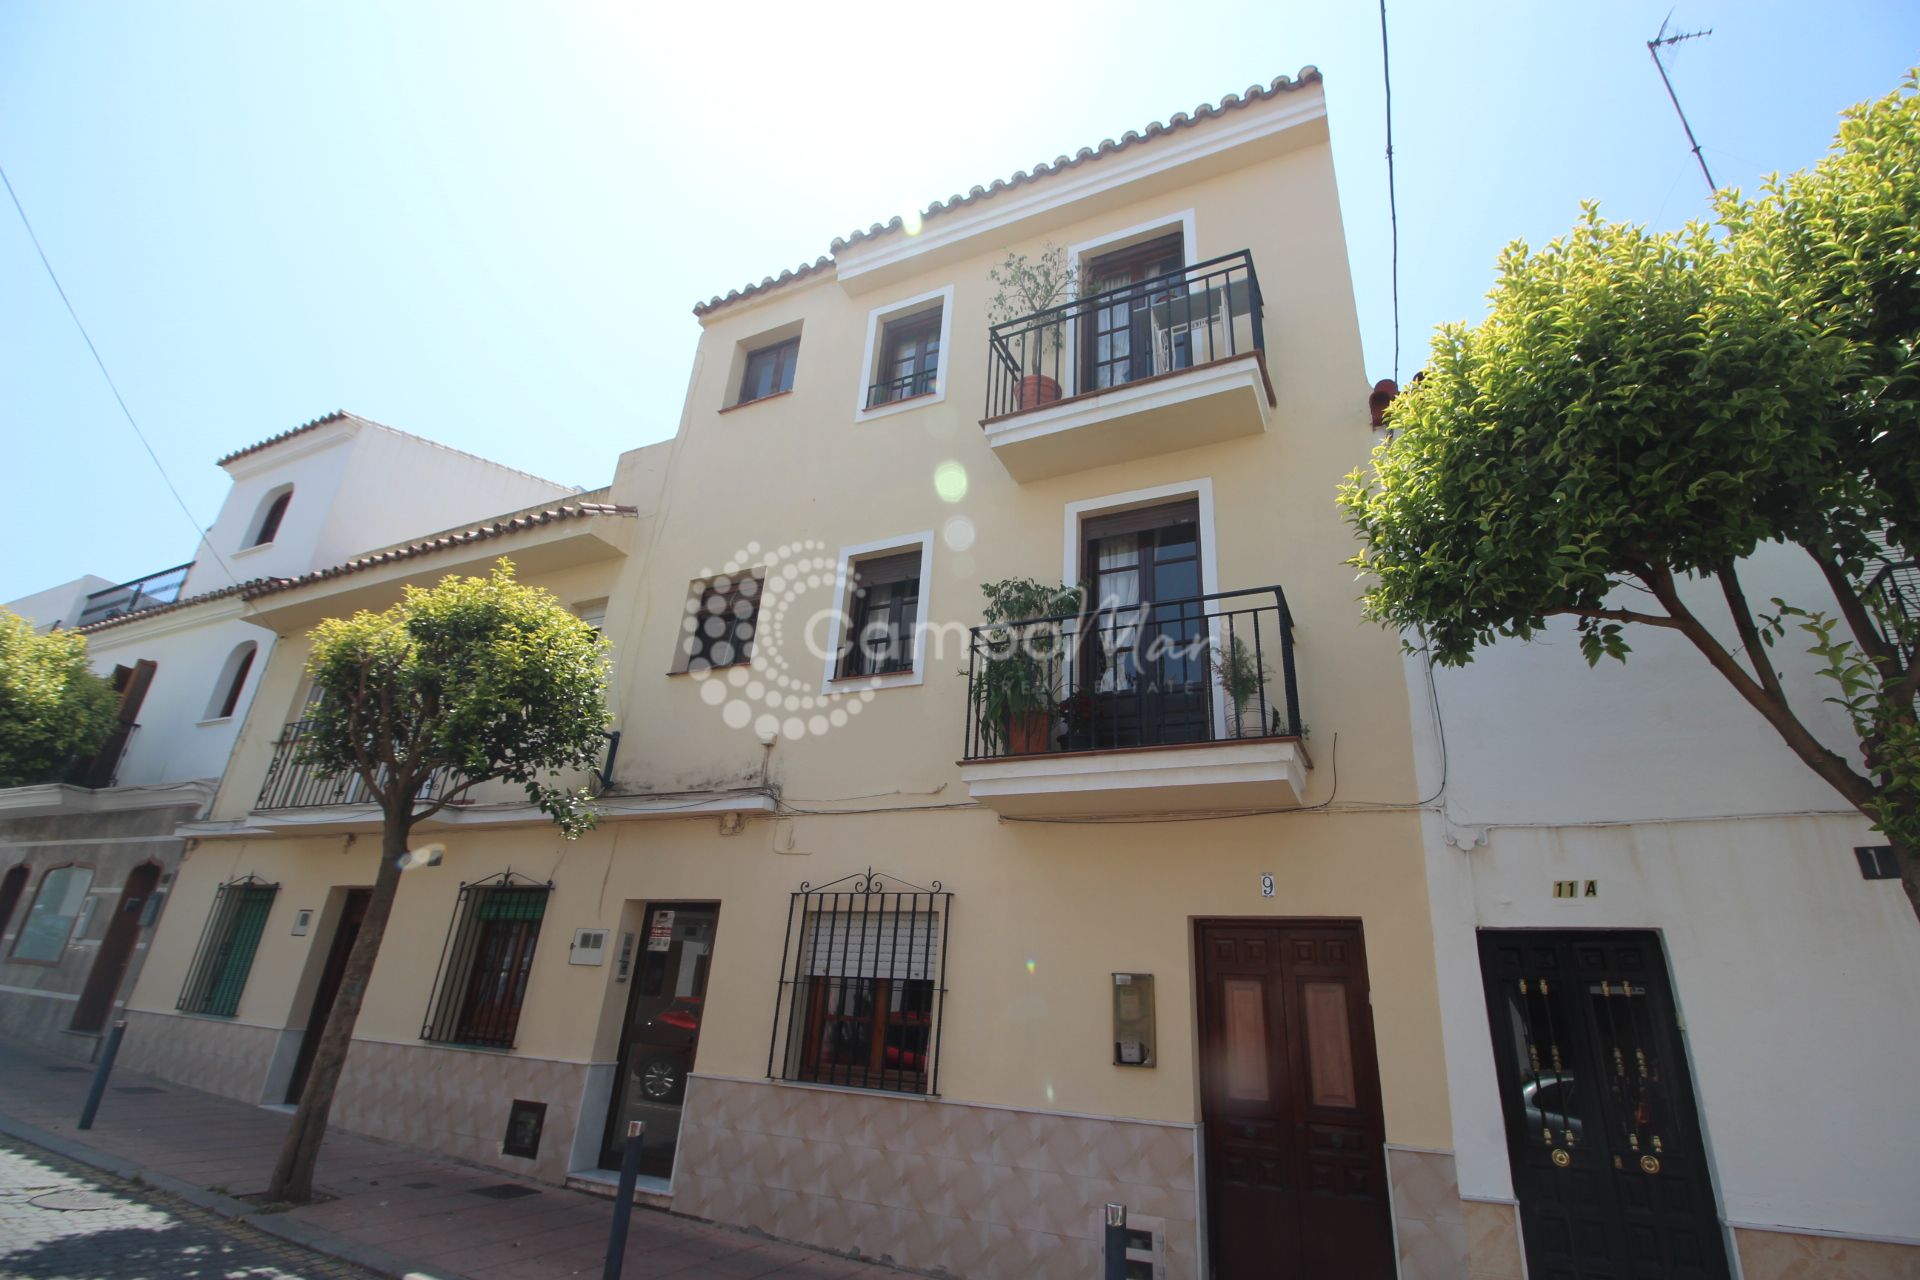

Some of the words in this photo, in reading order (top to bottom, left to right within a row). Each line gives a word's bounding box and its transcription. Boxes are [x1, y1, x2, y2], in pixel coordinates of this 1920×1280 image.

[1261, 875, 1274, 896] 9
[1555, 881, 1576, 898] 11
[1584, 880, 1597, 897] A
